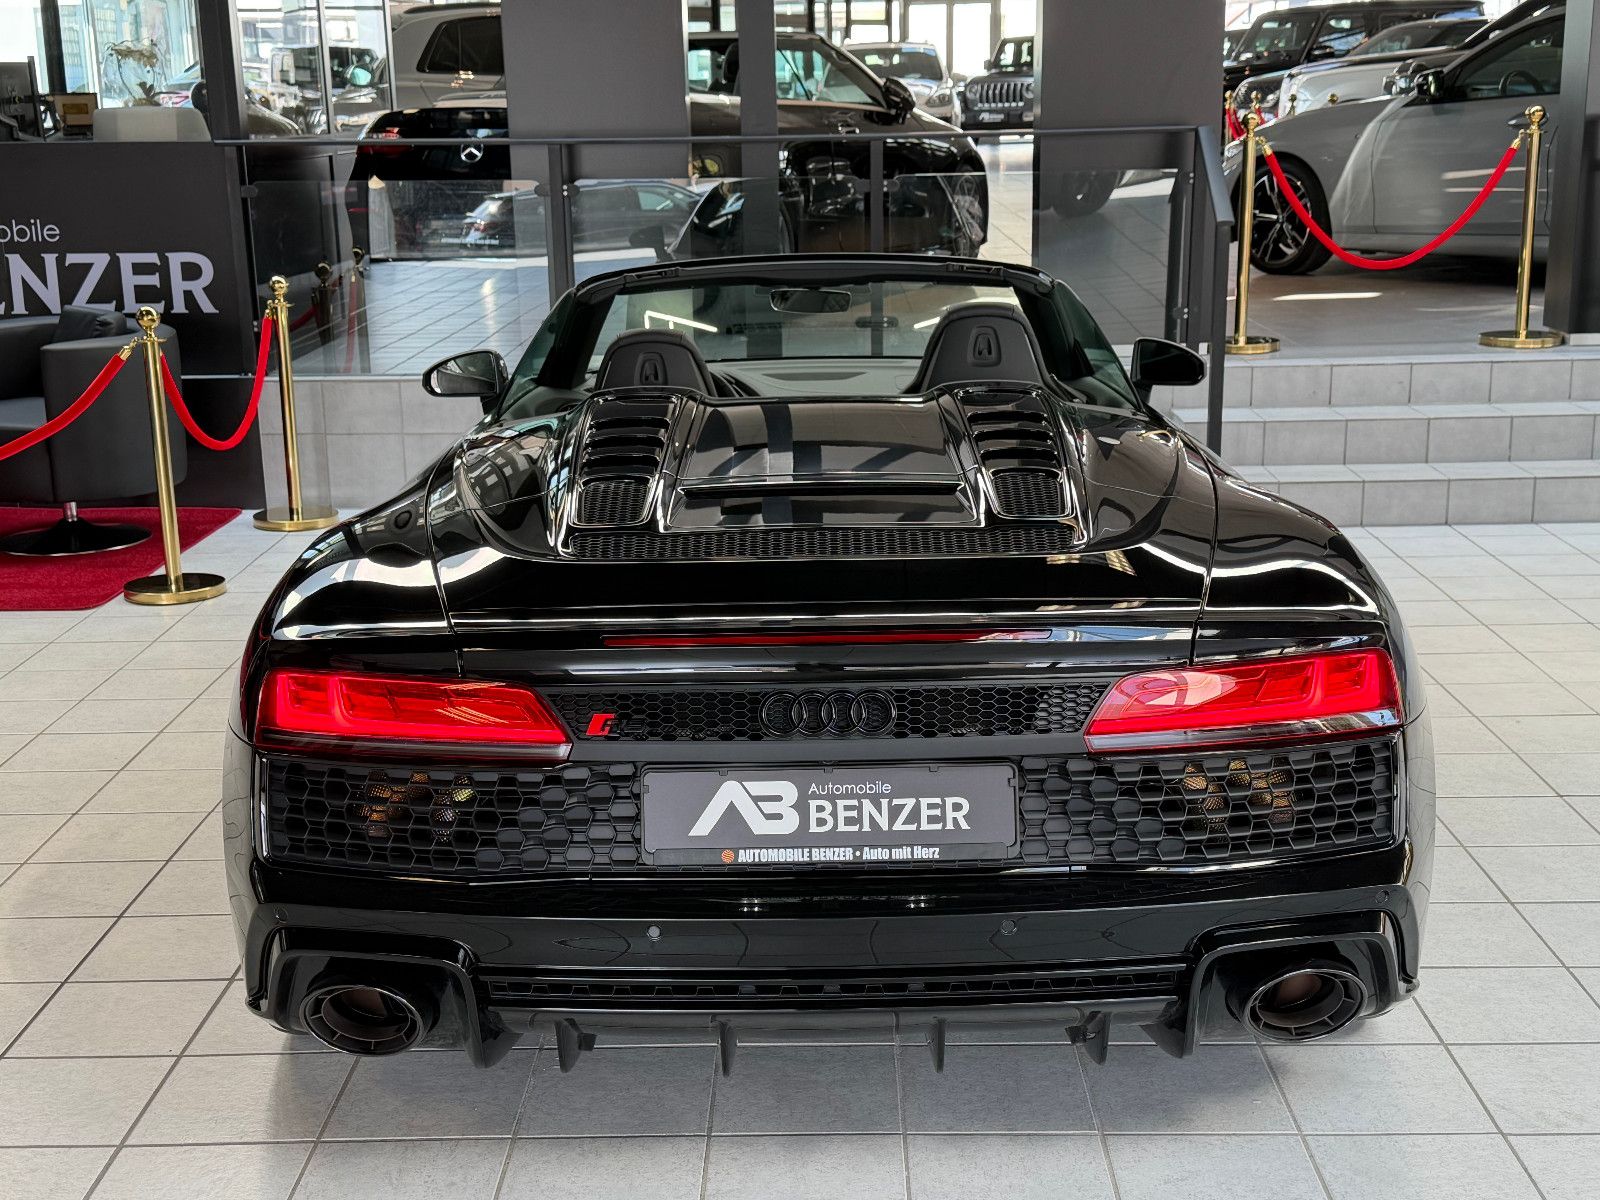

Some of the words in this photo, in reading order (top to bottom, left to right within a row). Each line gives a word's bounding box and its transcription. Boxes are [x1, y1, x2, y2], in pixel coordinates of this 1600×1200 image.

[0, 252, 219, 314] NZER
[808, 781, 892, 795] Automobile
[808, 796, 971, 833] BENZER
[737, 848, 810, 863] AUTOMOBILE
[811, 847, 853, 862] BENZER
[862, 846, 889, 860] Auto
[891, 846, 912, 860] mit
[913, 845, 940, 859] Herz
